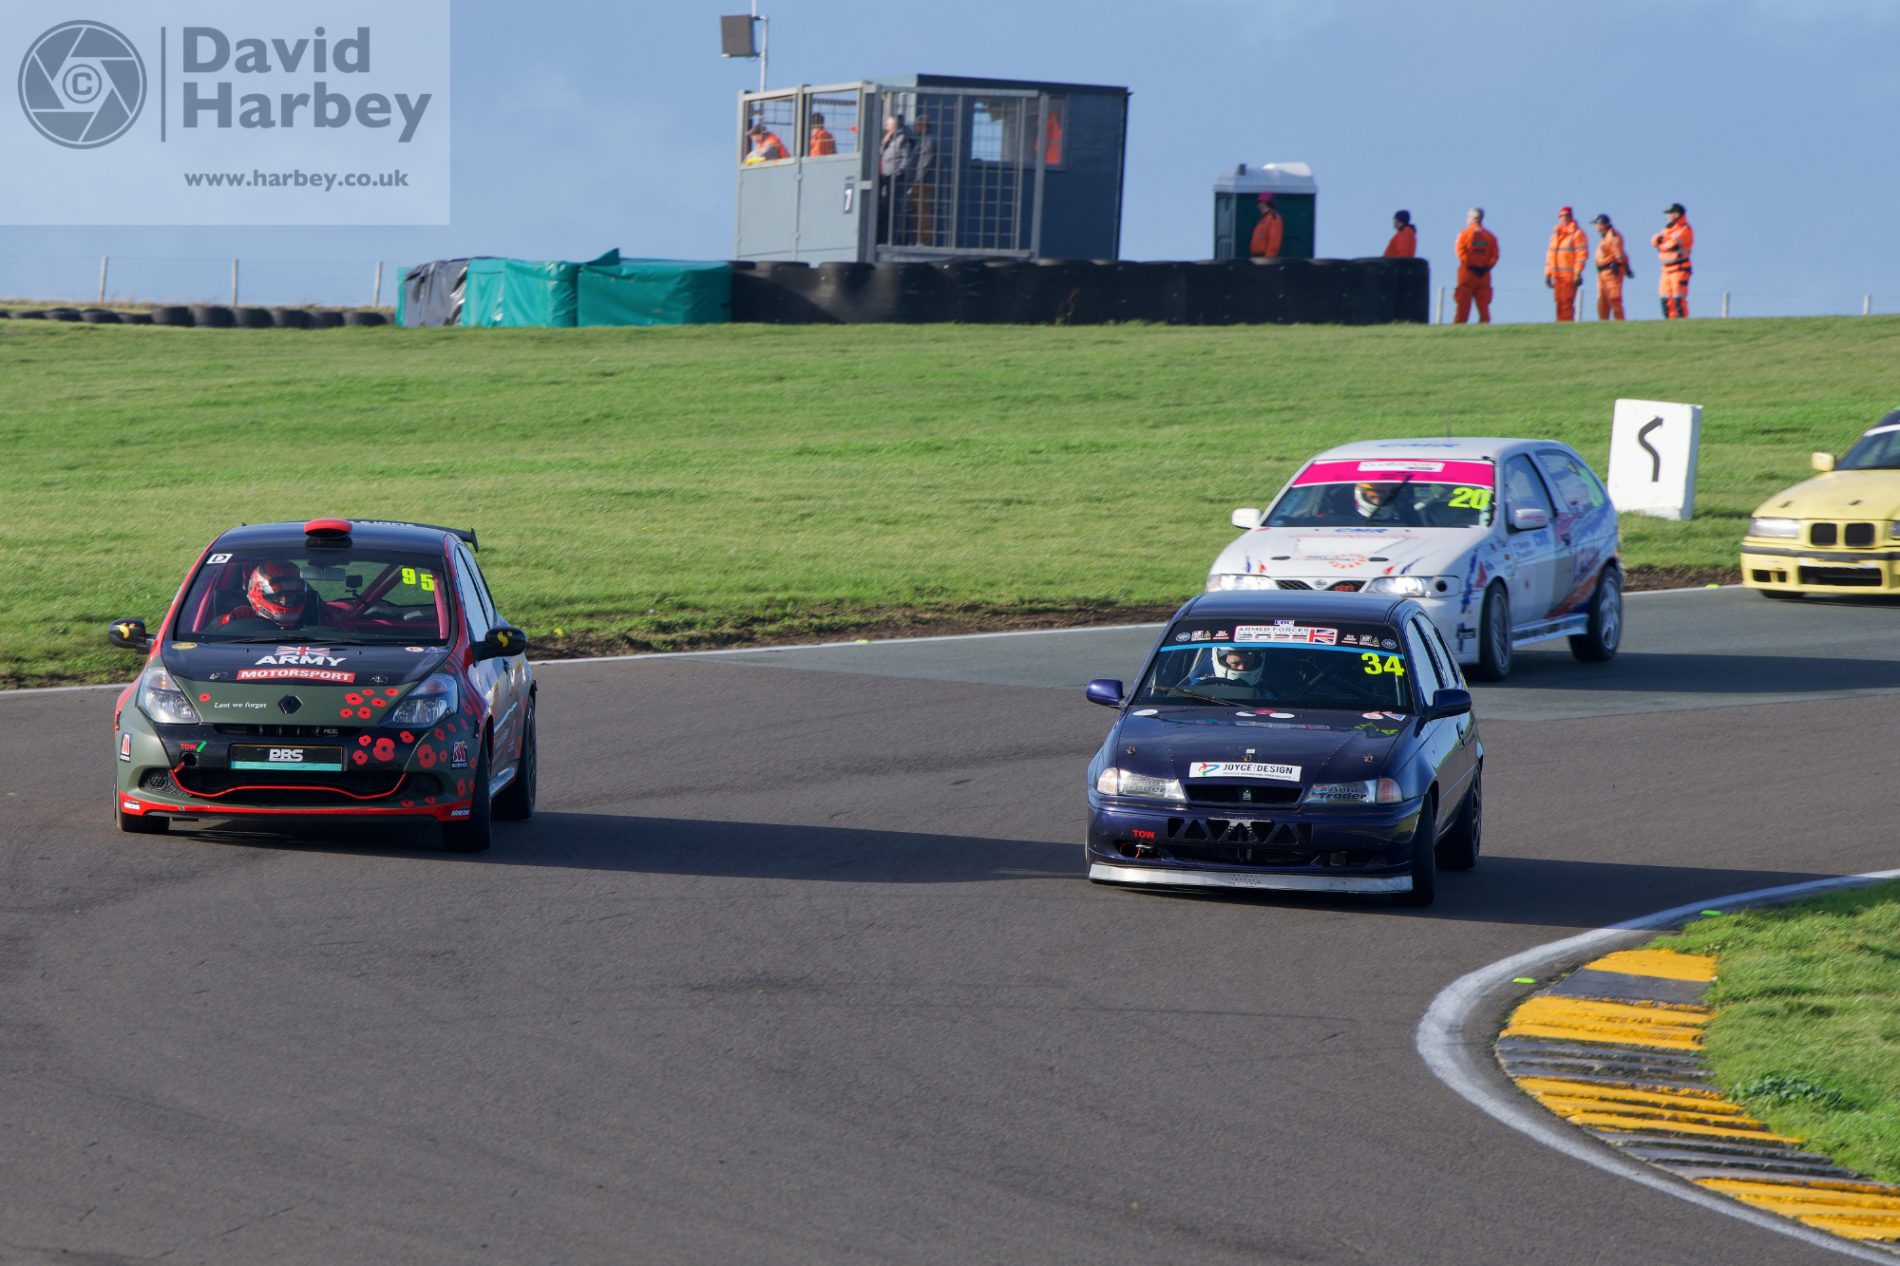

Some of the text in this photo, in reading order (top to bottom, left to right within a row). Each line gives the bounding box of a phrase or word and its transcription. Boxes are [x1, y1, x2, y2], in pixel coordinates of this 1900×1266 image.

[1448, 486, 1491, 509] 20
[401, 567, 435, 592] 95
[254, 655, 347, 667] ARMY
[1361, 652, 1405, 677] 34
[240, 669, 353, 681] MOTORSPORT
[1222, 763, 1252, 772] JOYCE
[1257, 764, 1293, 775] DESIGN
[1329, 785, 1358, 793] Auto
[1319, 792, 1367, 800] Trader
[1132, 828, 1155, 840] TOW
